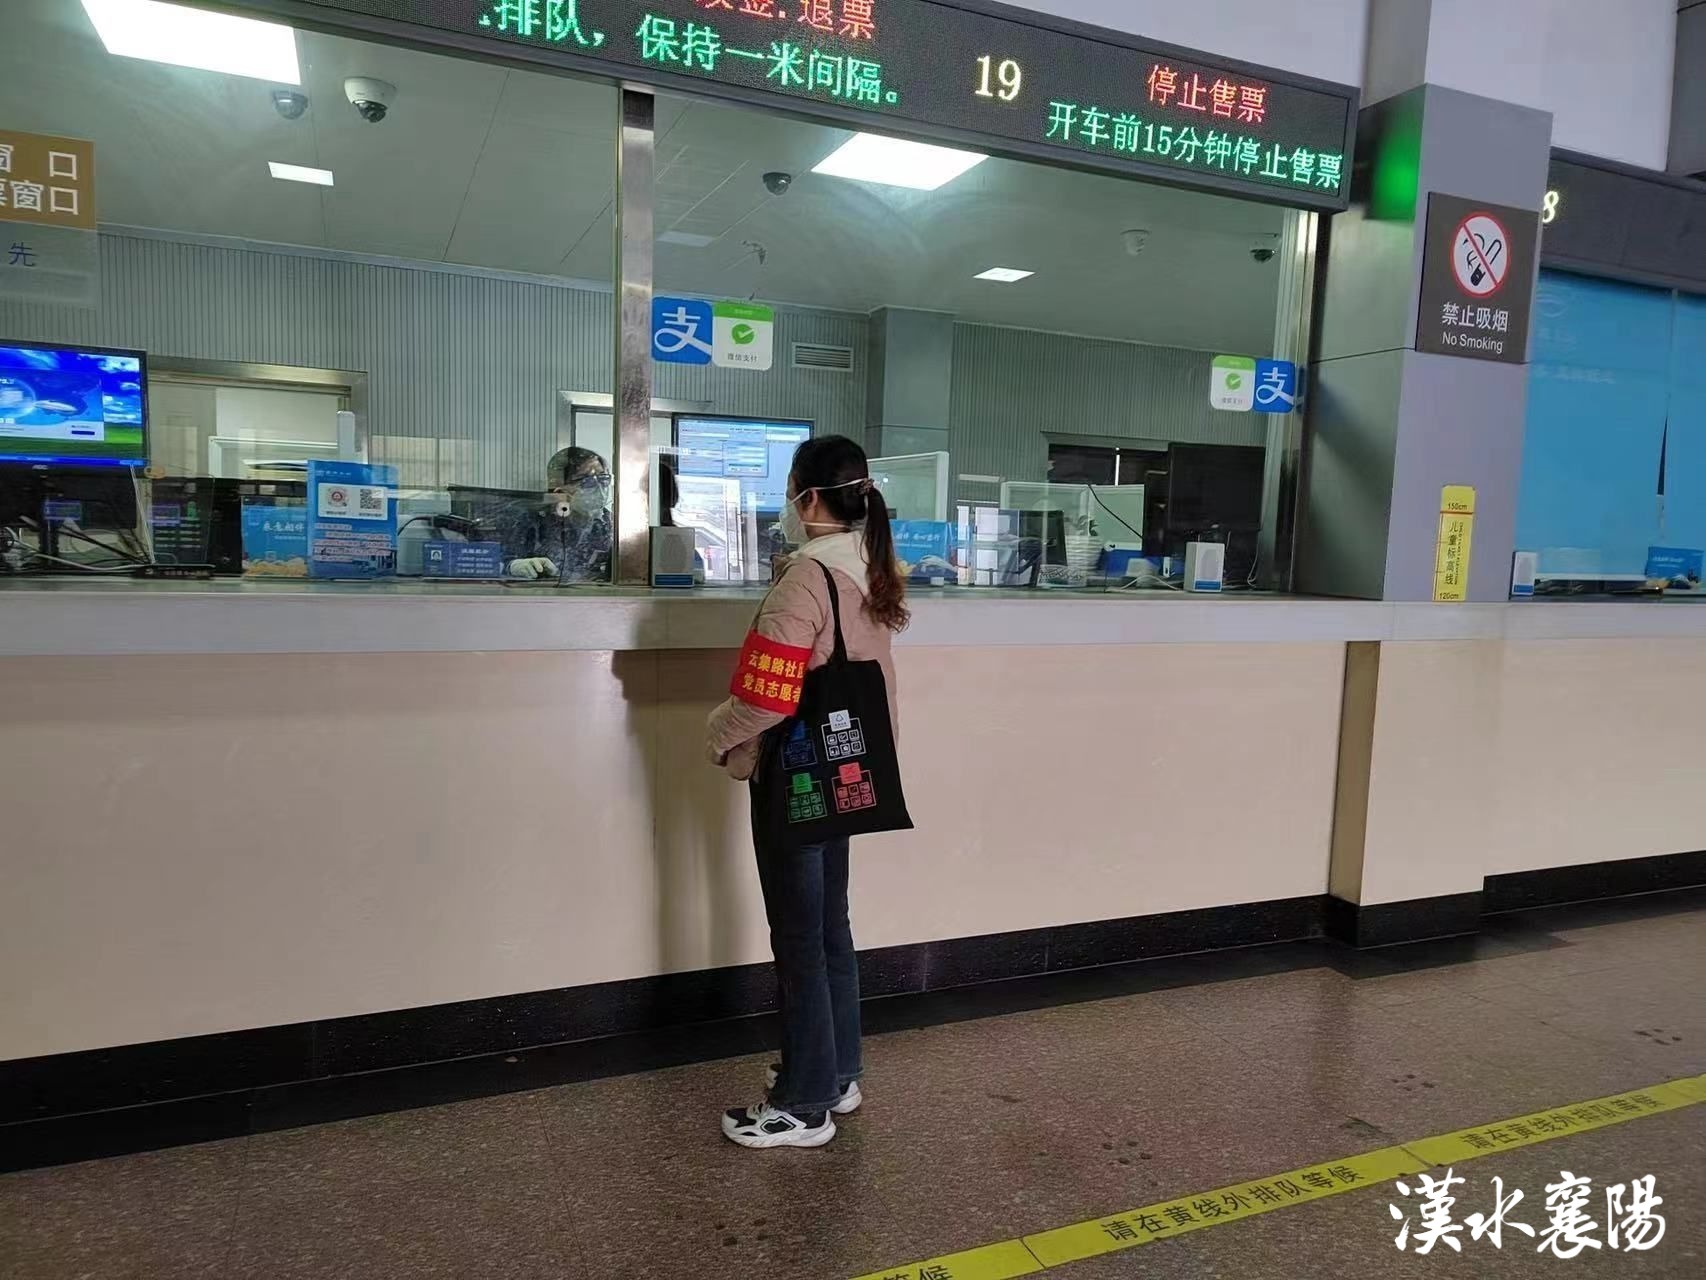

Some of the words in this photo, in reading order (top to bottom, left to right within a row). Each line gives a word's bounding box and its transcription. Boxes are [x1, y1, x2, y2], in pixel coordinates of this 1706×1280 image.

[696, 0, 875, 39] .退票
[976, 55, 1022, 100] 19
[1147, 64, 1267, 123] 停止售票
[1046, 101, 1343, 189] 开车前15分钟停止售票
[0, 179, 78, 215] 窗口
[8, 242, 38, 267] 先
[1442, 302, 1509, 332] 禁止吸烟
[1442, 331, 1457, 346] No
[1460, 333, 1503, 354] Smoking
[1448, 502, 1468, 510] 150cm
[1102, 1165, 1365, 1242] 请在黄线外排队等候
